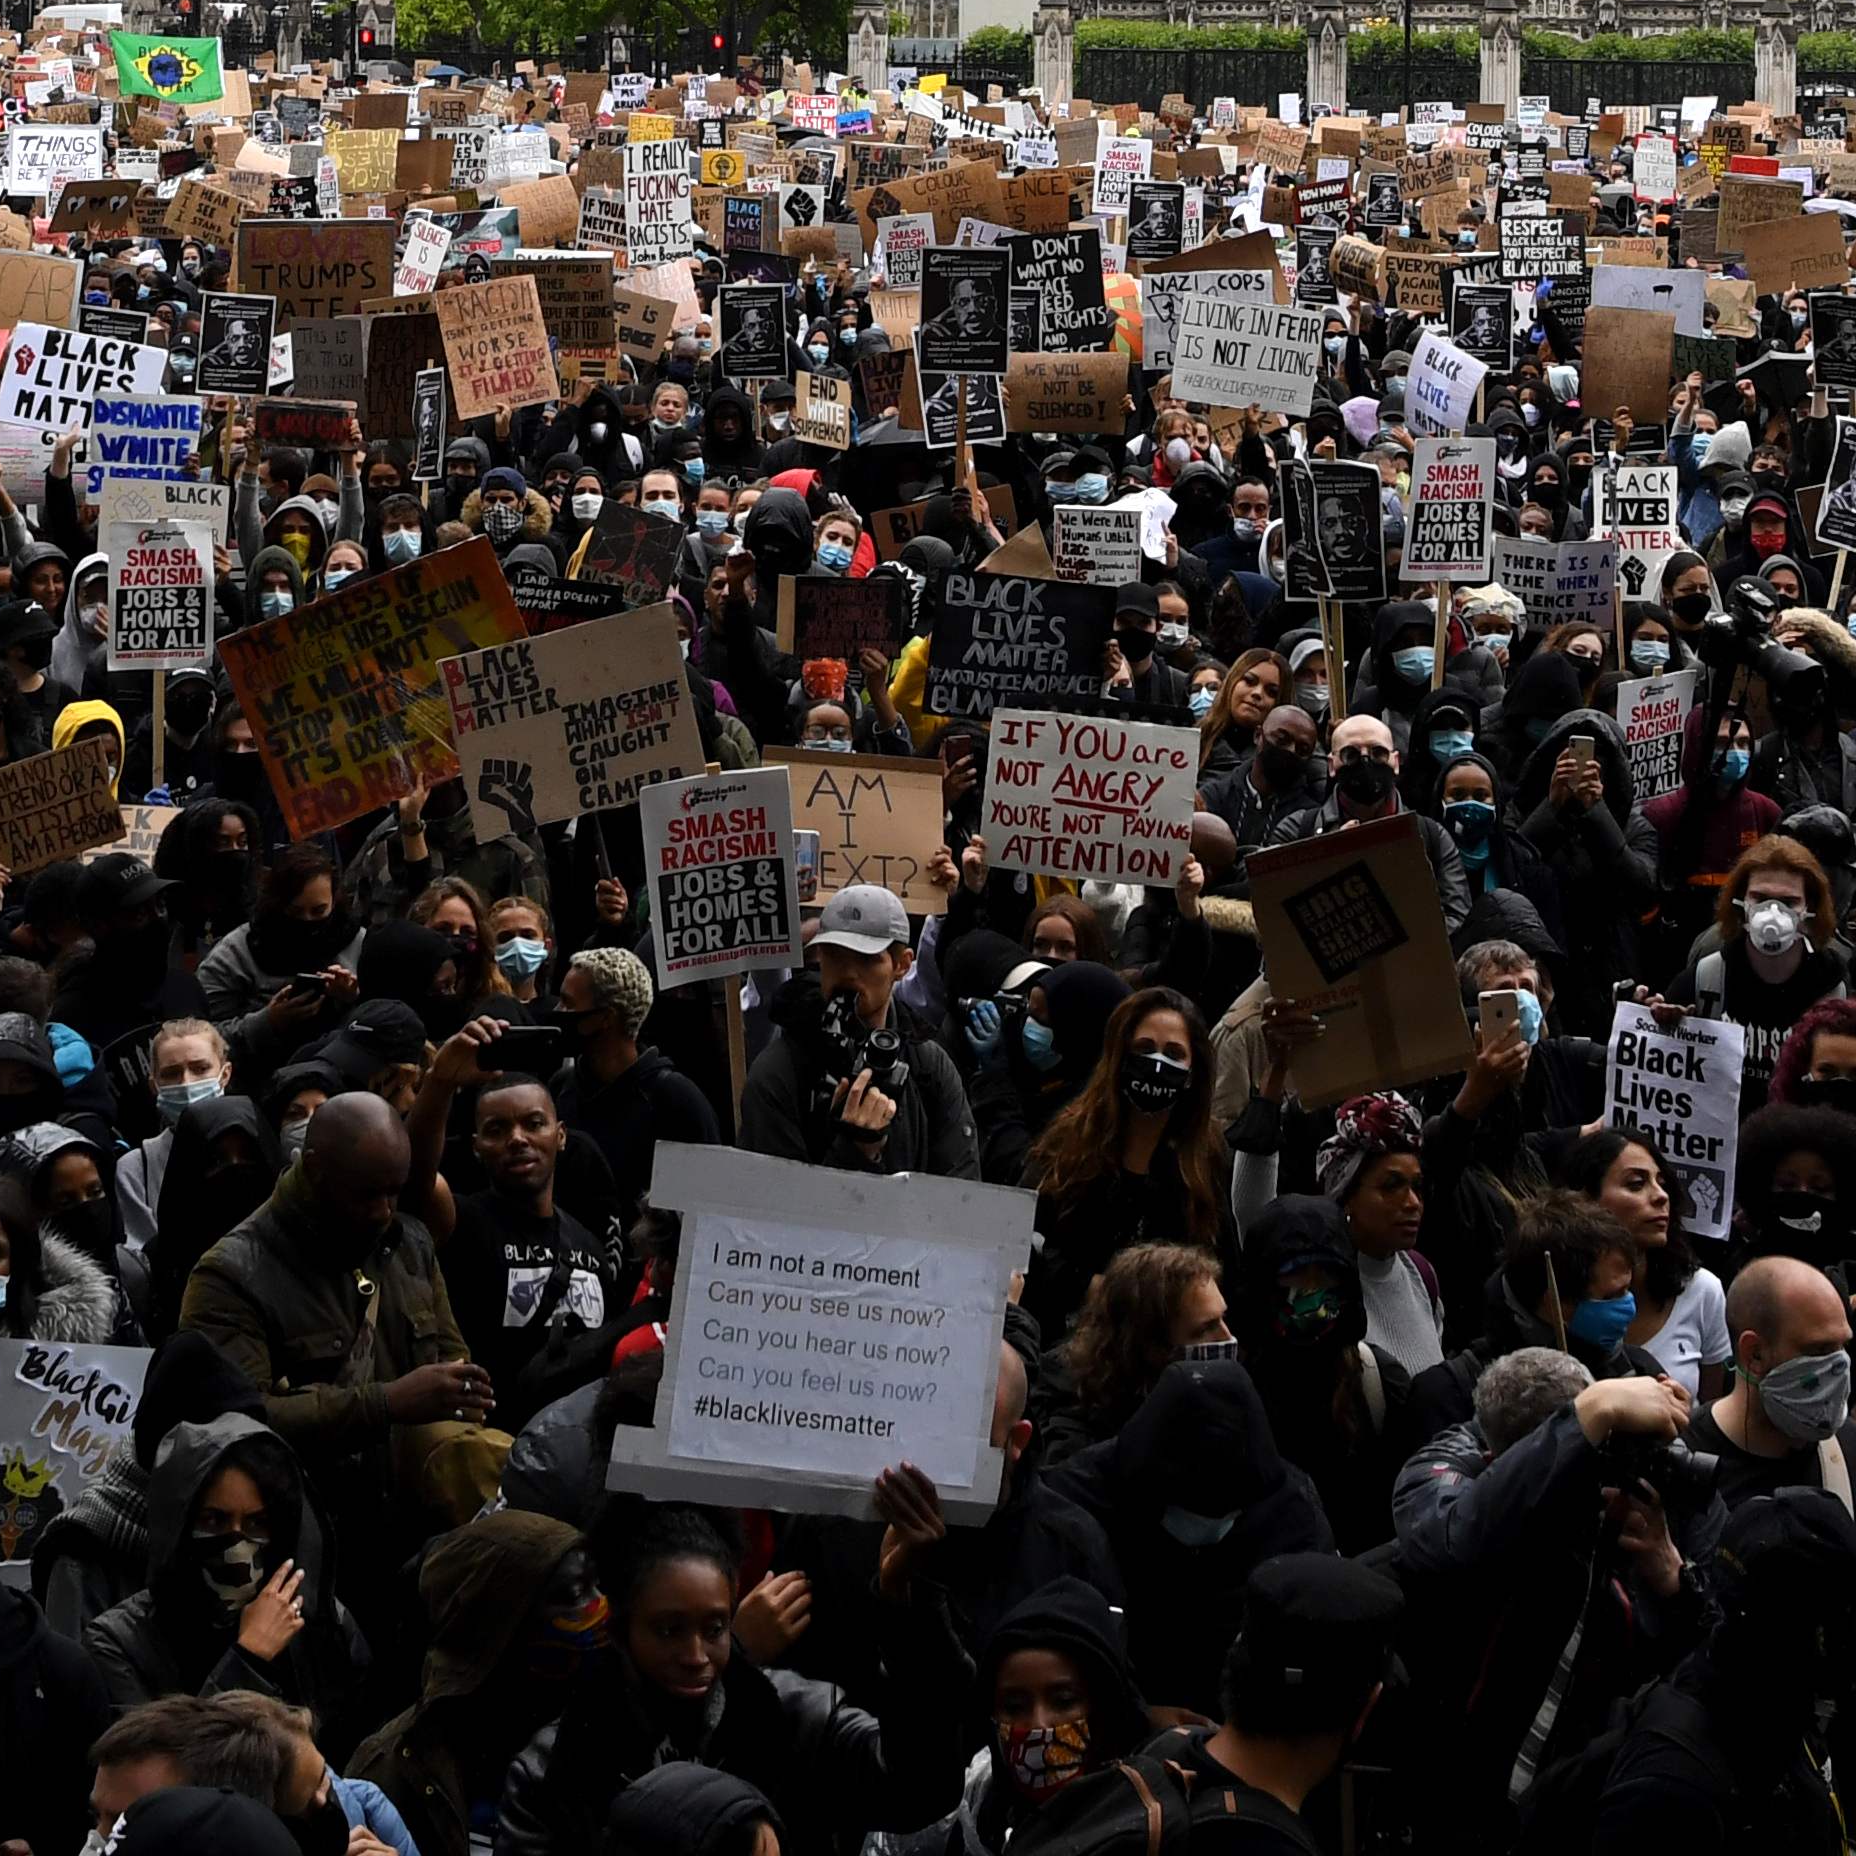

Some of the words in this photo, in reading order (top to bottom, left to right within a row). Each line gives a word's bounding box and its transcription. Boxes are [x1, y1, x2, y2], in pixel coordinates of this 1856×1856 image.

[643, 140, 687, 171] REALLY
[628, 173, 689, 202] FUCKING
[639, 201, 673, 223] HATE
[1501, 218, 1564, 236] RESPECT
[1502, 236, 1529, 246] BLACK
[1531, 236, 1555, 246] LIVES
[1556, 236, 1580, 246] LIKE
[1502, 246, 1521, 259] YOU
[1523, 247, 1567, 259] RESPECT
[1502, 260, 1540, 277] BLACK
[1541, 260, 1583, 275] CULTURE
[1182, 299, 1246, 332] LIVING
[1248, 307, 1273, 336] IN
[1275, 313, 1321, 344] FEAR
[1181, 334, 1205, 360] IS
[1213, 338, 1251, 367] NOT
[1257, 346, 1314, 377] LIVING
[809, 374, 838, 401] END
[1183, 374, 1297, 403] #BLACKLIVESMATTER
[806, 397, 845, 425] WHITE
[796, 417, 847, 444] SUPREMACY
[999, 720, 1046, 749] IF
[1055, 718, 1127, 762] YOU
[1132, 744, 1189, 769] are
[995, 757, 1045, 787] NOT
[1051, 763, 1164, 806] ANGRY
[990, 799, 1051, 833] YOU'RE
[1062, 813, 1106, 835] NOT
[1122, 814, 1191, 841] PAYING
[1001, 834, 1170, 878] ATTENTION
[1156, 1062, 1161, 1073] I
[1616, 1031, 1707, 1083] Black
[1131, 1080, 1176, 1098] CAN'T
[1614, 1067, 1692, 1118] Lives
[713, 1243, 719, 1264] I
[726, 1249, 761, 1268] am
[769, 1254, 804, 1274] not
[811, 1260, 824, 1276] a
[832, 1262, 921, 1288] moment
[708, 1281, 753, 1306] Can
[762, 1291, 802, 1313] you
[810, 1298, 850, 1317] see
[857, 1304, 883, 1322] us
[889, 1307, 945, 1328] now?
[703, 1319, 748, 1344] Can
[757, 1329, 797, 1351] you
[805, 1331, 856, 1355] hear
[863, 1342, 888, 1360] us
[895, 1345, 950, 1366] now?
[698, 1356, 744, 1381] Can
[752, 1366, 793, 1388] you
[801, 1369, 841, 1392] feel
[848, 1379, 875, 1397] us
[881, 1382, 937, 1403] now?
[694, 1395, 896, 1438] #blacklivesmatter
